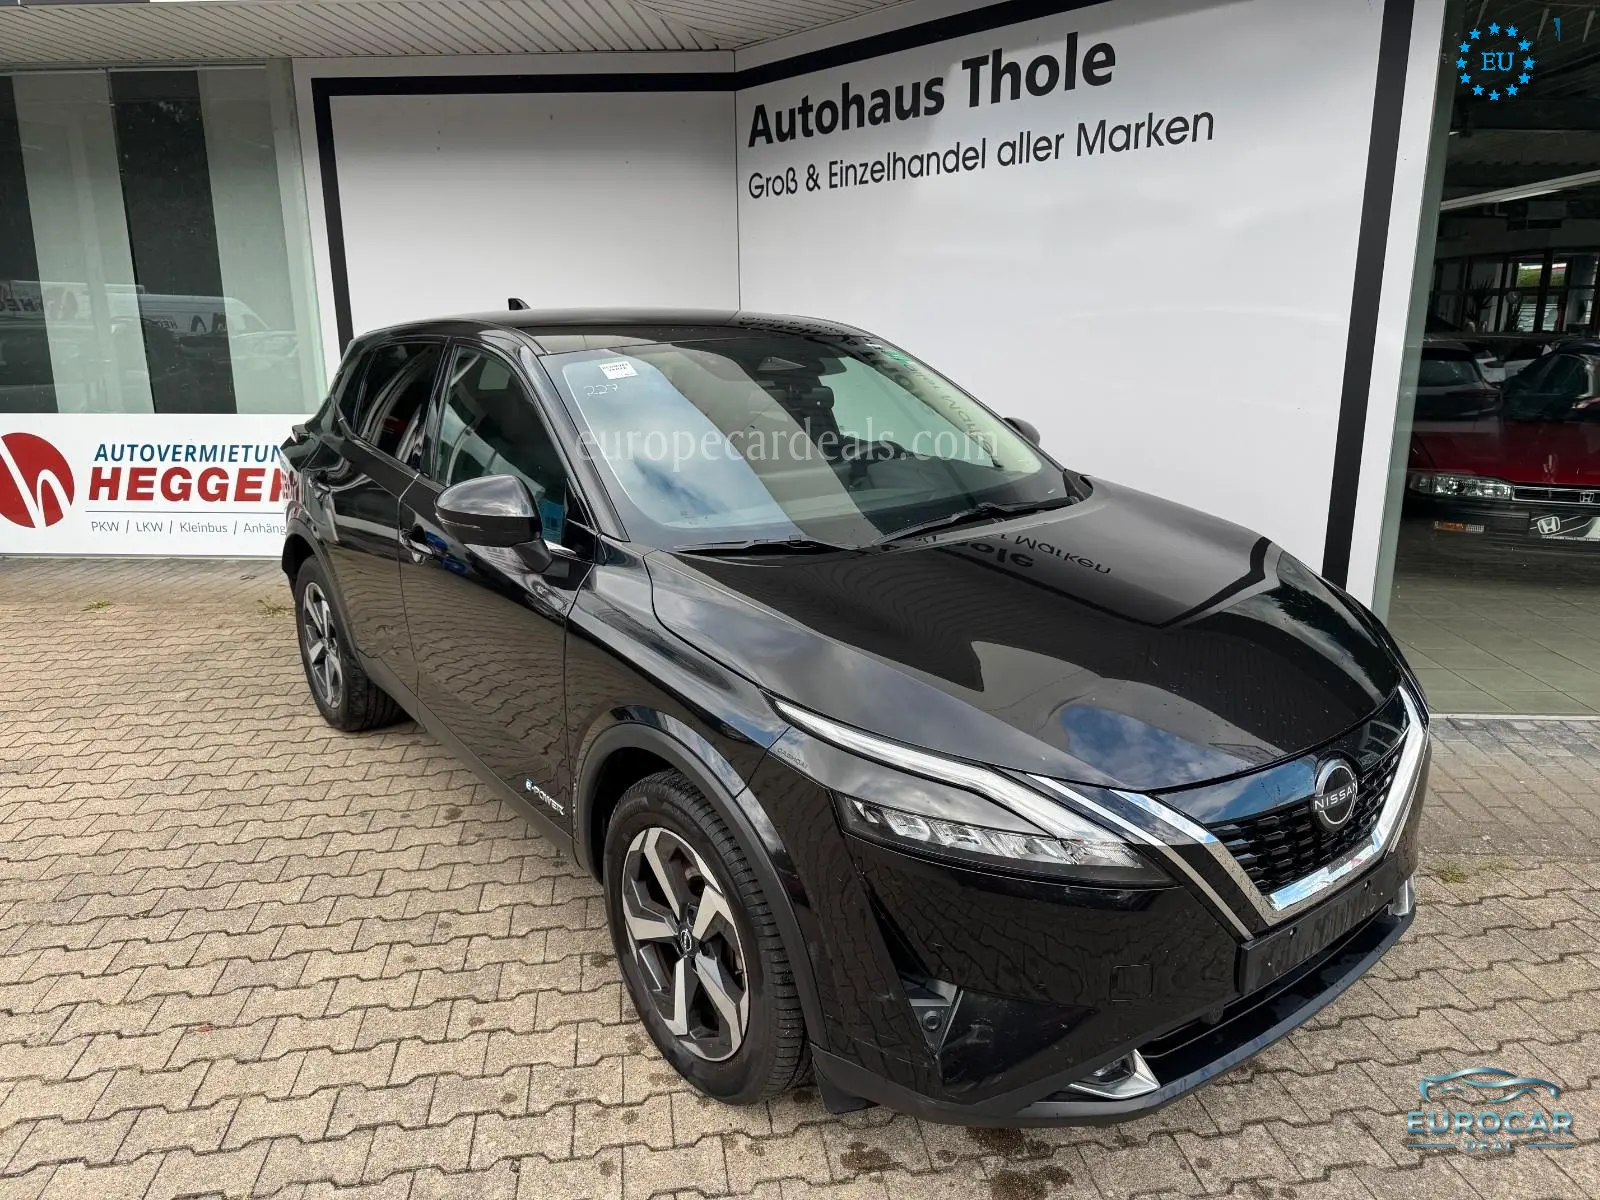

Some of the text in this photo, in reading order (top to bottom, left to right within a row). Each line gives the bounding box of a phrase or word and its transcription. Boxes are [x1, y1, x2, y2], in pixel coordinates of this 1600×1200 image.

[748, 31, 1116, 148] Autohaus Thole
[748, 111, 1214, 199] Groß & Einzelhandel aller Marken
[91, 521, 120, 533] PKW
[136, 521, 163, 533] LKW
[179, 521, 228, 534] Kleinbus
[1314, 780, 1358, 811] NISSAN
